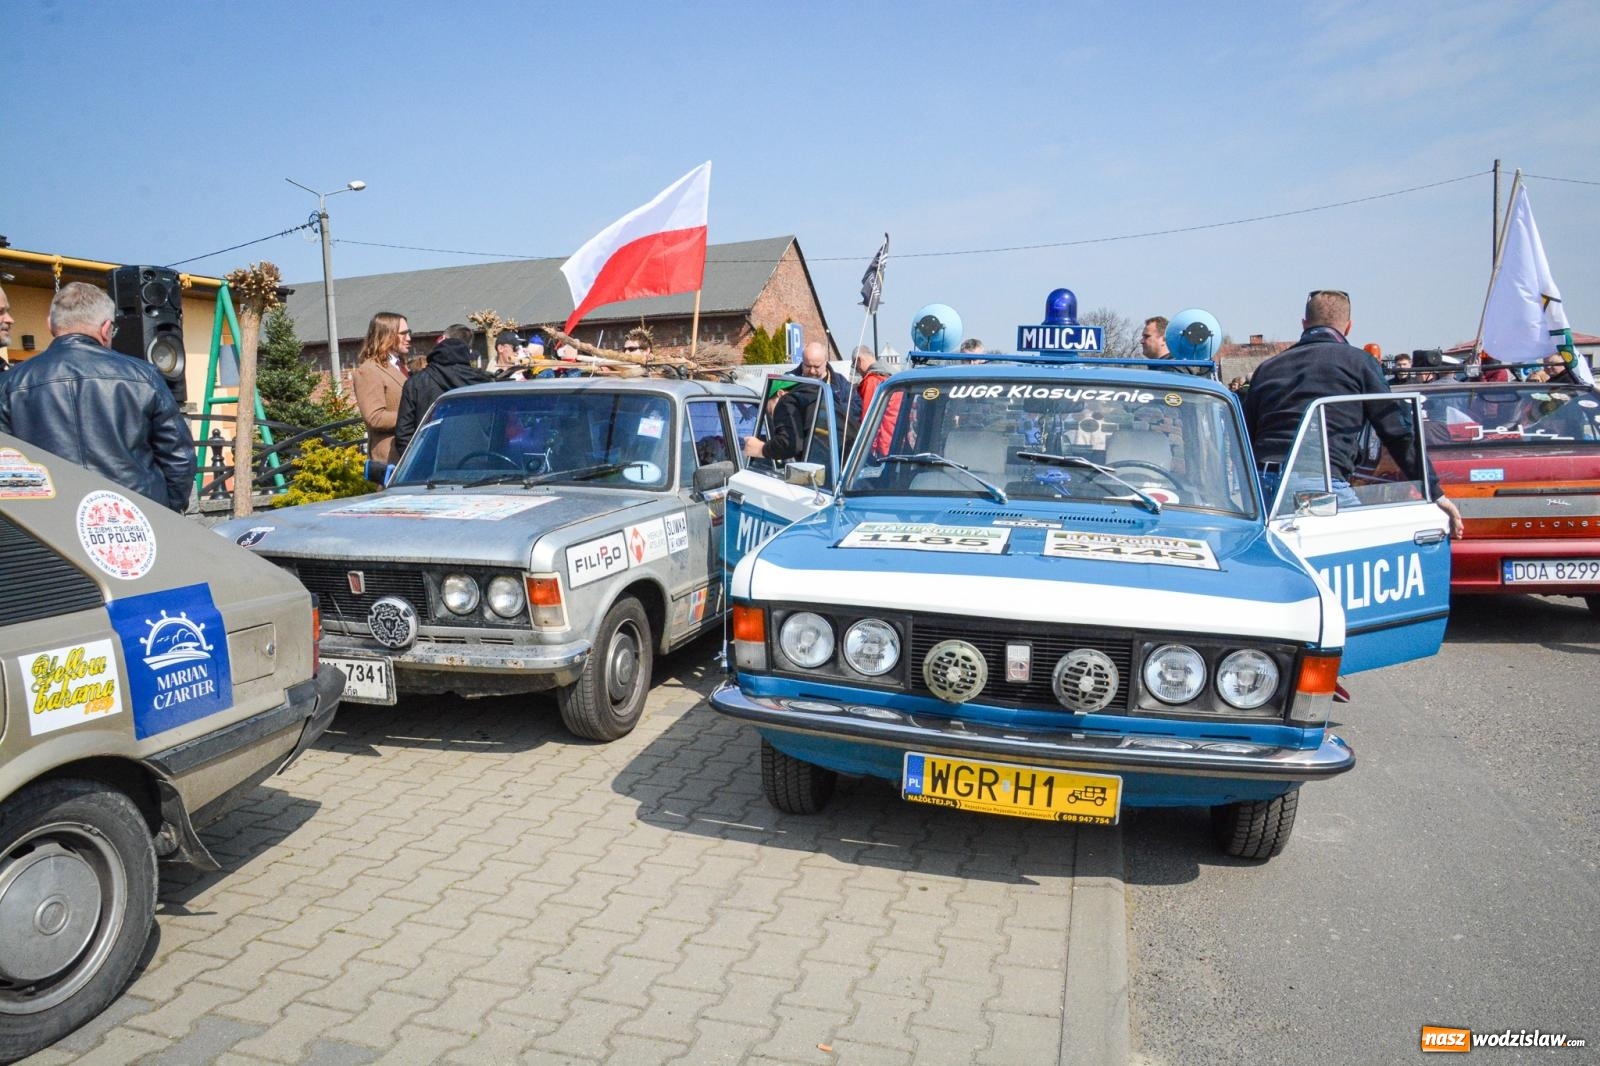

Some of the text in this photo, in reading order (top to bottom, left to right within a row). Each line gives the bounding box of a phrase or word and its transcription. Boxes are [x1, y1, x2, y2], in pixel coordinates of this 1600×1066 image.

[1022, 327, 1097, 350] MILICJA
[949, 385, 1155, 403] WGR Klasycznie
[90, 532, 147, 545] DO POLSKI
[859, 533, 989, 547] 1185
[1054, 543, 1205, 560] 2449
[1514, 563, 1549, 580] DOA
[1556, 562, 1600, 579] 8299
[157, 664, 208, 691] MARIAN
[346, 664, 384, 683] 7341
[153, 679, 215, 710] CZARTER
[908, 762, 1055, 808] PL WGR H1
